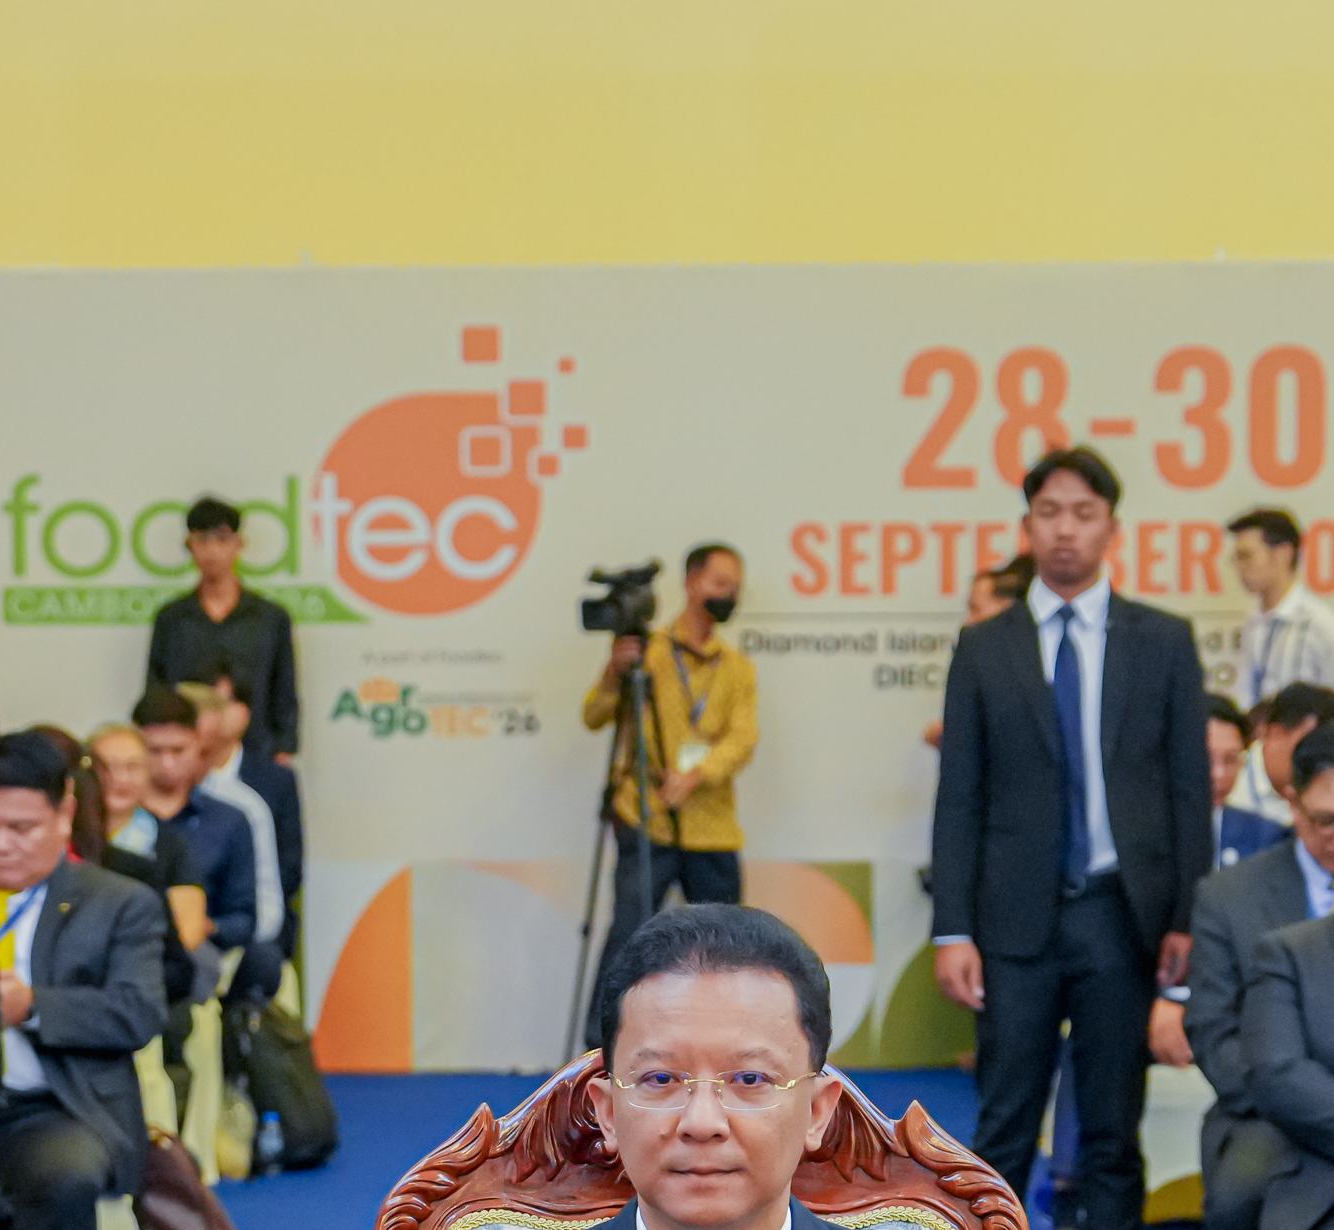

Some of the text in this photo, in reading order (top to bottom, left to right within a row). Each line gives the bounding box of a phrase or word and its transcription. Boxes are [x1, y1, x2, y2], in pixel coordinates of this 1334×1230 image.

[901, 343, 1327, 490] 28-30
[789, 520, 1223, 597] SEPTEBER
[7, 588, 155, 618] CAMBO
[740, 628, 956, 655] Diamond Islan
